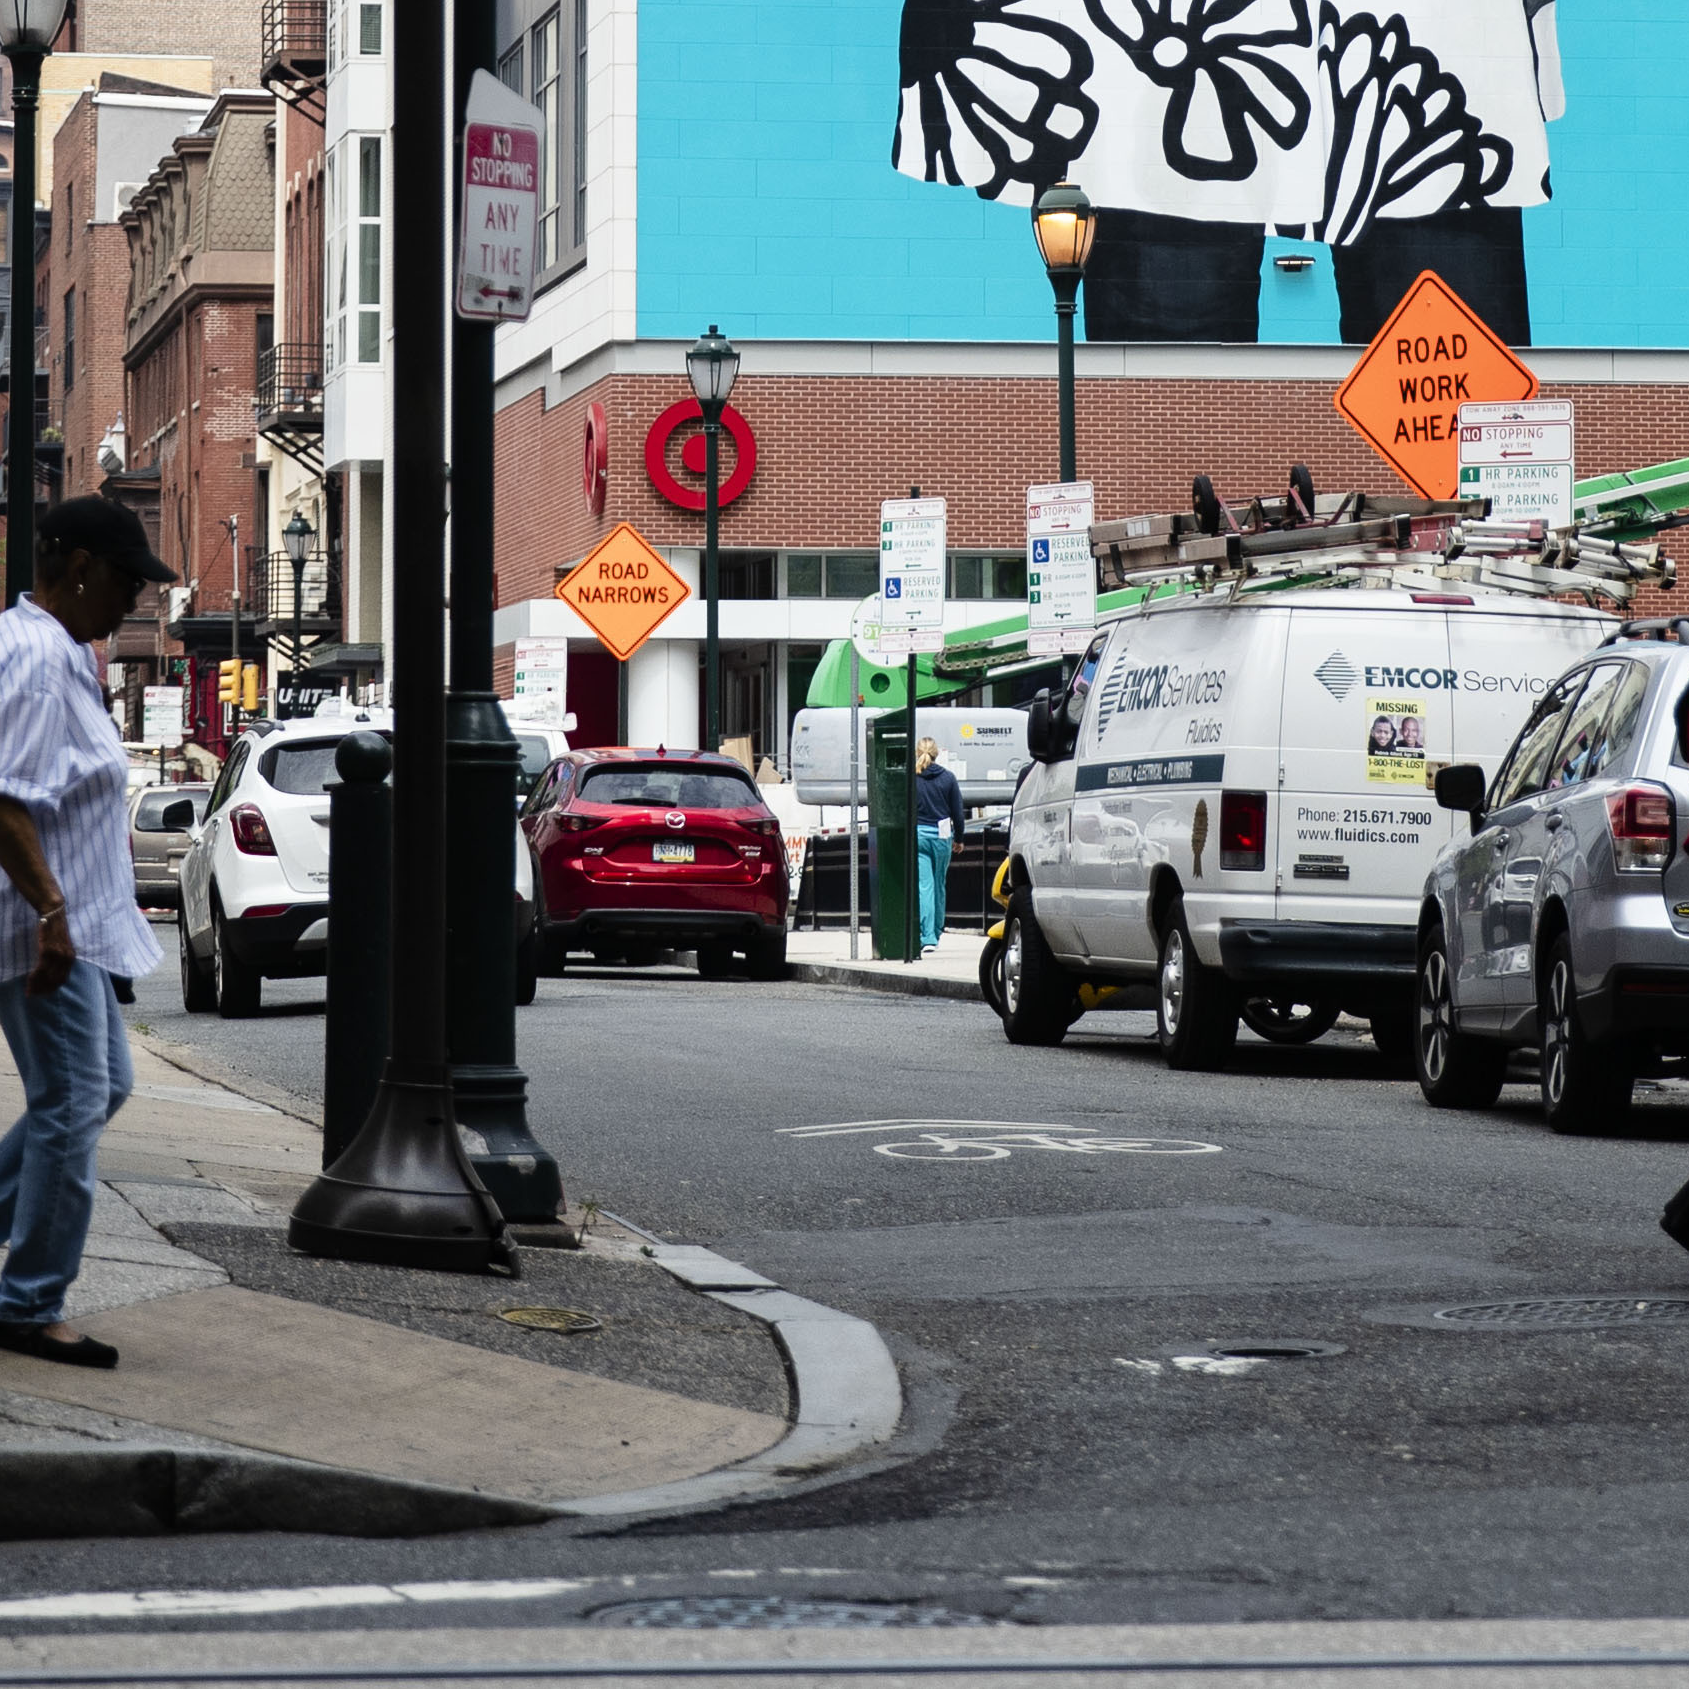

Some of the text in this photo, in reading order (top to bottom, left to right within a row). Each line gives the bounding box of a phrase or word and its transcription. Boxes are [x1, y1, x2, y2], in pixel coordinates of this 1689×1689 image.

[492, 131, 512, 157] NO
[471, 157, 533, 188] STOPPING
[484, 201, 520, 233] ANY
[480, 243, 521, 277] TIME
[1396, 333, 1468, 365] ROAD
[1399, 372, 1470, 404] WORK
[1394, 413, 1458, 444] AHEA
[1462, 427, 1544, 441] NO STOPPING
[1468, 466, 1559, 481] 1 HR PARKING
[1507, 493, 1559, 506] PARKING
[1029, 507, 1040, 519] NO
[1043, 504, 1082, 517] STOPPING
[906, 520, 936, 530] PARKING
[906, 539, 936, 549] PARKING
[1051, 536, 1091, 549] RESERVED
[1053, 551, 1090, 563] PARKING
[598, 562, 649, 580] ROAD
[903, 575, 941, 587] RESERVED
[578, 586, 669, 604] NARROWS
[905, 588, 940, 599] PARKING
[1033, 592, 1039, 603] 3
[1116, 660, 1226, 713] EMCOR Services
[1364, 666, 1558, 693] EMCOR Service
[1375, 702, 1418, 714] MISSING
[976, 727, 1013, 735] SUNBELT
[1185, 716, 1223, 744] Fluidics
[1368, 758, 1425, 769] 1-800-THE-LOST
[1297, 807, 1432, 826] Phone: 215.671.7900
[1297, 827, 1419, 844] www.fluidics.com
